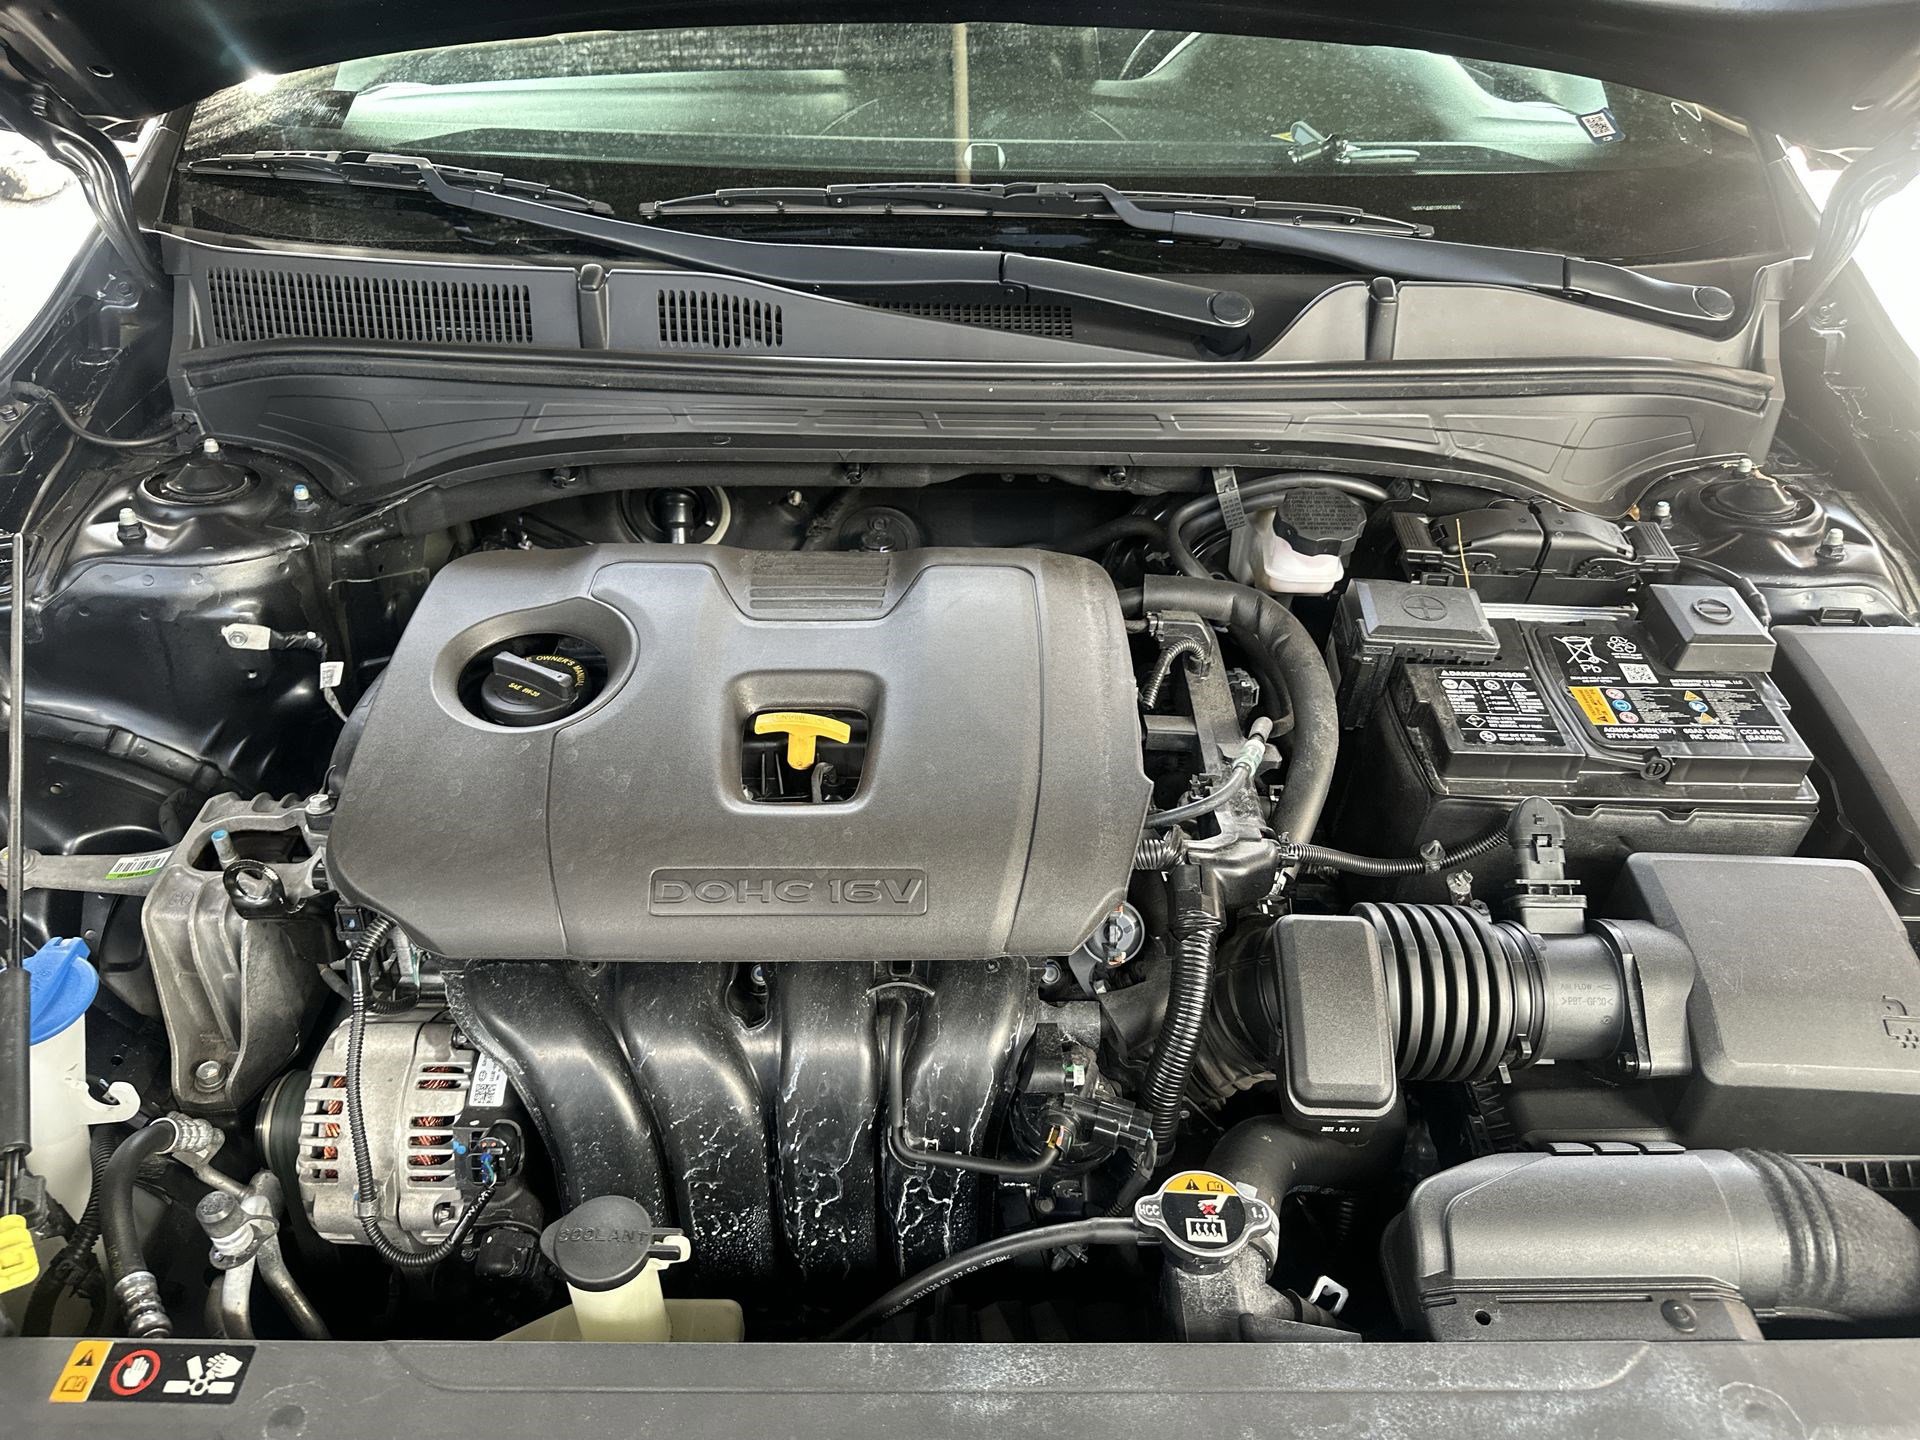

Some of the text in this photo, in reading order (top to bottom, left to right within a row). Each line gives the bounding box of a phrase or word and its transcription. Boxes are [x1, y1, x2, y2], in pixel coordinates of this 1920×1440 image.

[536, 655, 575, 666] OWNER'S
[1580, 664, 1602, 673] Pb
[653, 879, 923, 904] DOHC 16V
[1573, 983, 1593, 991] FLOW
[1138, 1203, 1161, 1217] HCC
[557, 1226, 649, 1246] COOLANT
